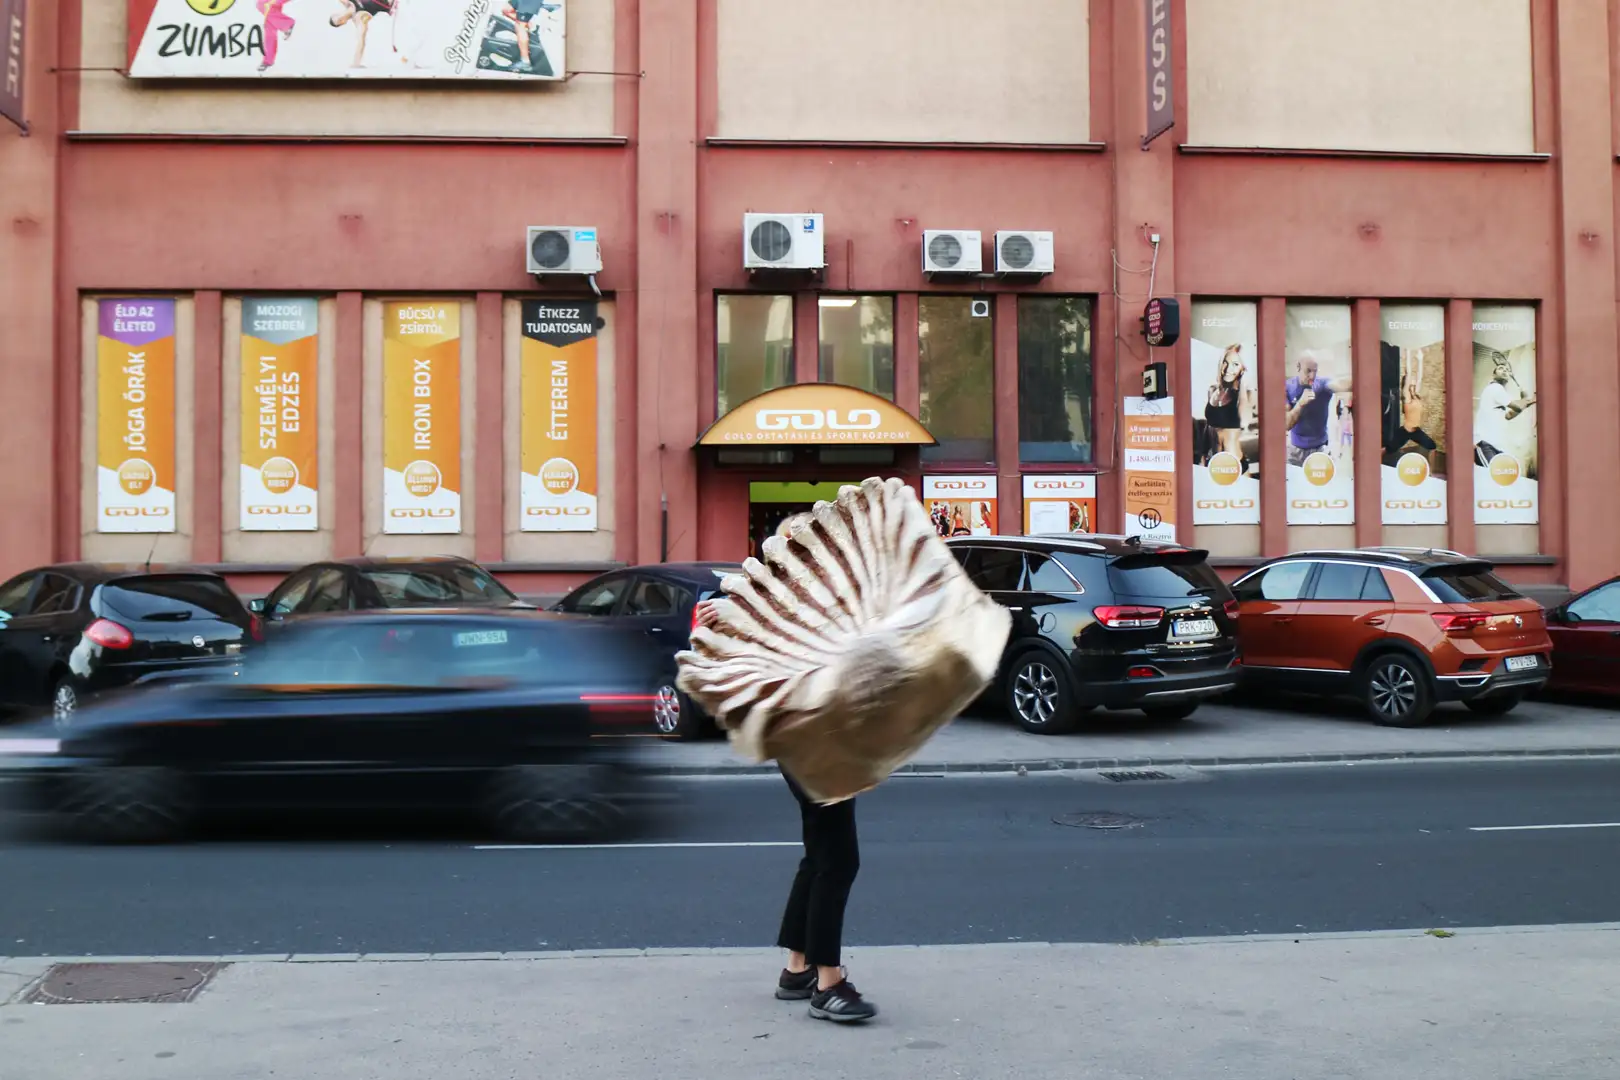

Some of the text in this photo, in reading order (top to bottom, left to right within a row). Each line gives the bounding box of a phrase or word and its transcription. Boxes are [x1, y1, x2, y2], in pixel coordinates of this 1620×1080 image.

[157, 22, 266, 59] ZUMBA
[443, 0, 491, 74] Spinning
[113, 318, 155, 332] ÉLETED
[115, 304, 154, 317] ÉLD AZ
[438, 309, 446, 320] A
[539, 305, 580, 319] ÉTKEZZ
[253, 320, 305, 331] SZEBBEN
[526, 322, 592, 334] TUDATOSAN
[413, 358, 432, 397] BOX
[122, 351, 147, 453] JÓGA ÓRÁK
[255, 355, 277, 449] SZEMÉLYI
[277, 371, 300, 432] EDZÉS
[546, 359, 568, 441] ÉTTEREM
[413, 403, 432, 450] IRON
[755, 409, 881, 430] GOLD
[1179, 620, 1213, 633] PRK-720
